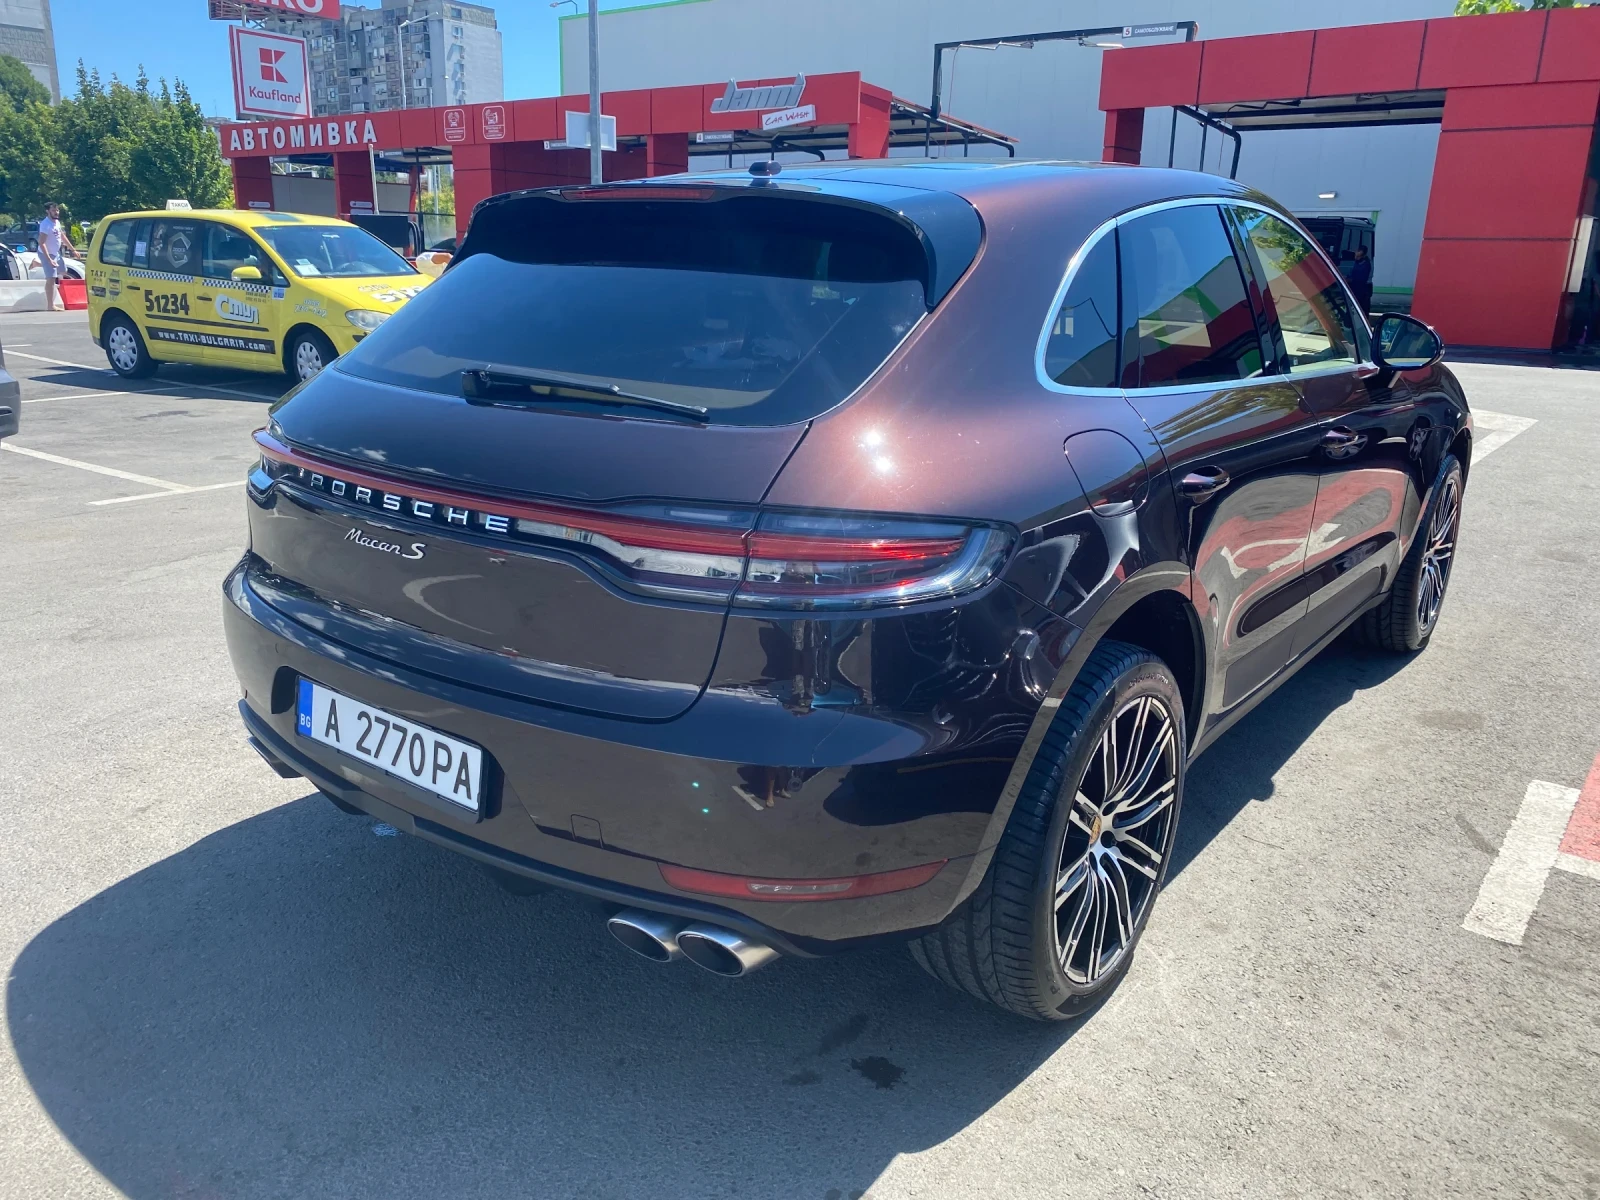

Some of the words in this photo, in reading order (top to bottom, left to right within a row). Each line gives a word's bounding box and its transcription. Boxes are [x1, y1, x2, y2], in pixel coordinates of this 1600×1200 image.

[249, 86, 301, 104] Kaufland
[230, 119, 377, 151] АВТОМИВКА
[91, 270, 106, 278] TAXI
[144, 290, 190, 315] 51234
[157, 331, 266, 351] www.TAXI-BULGARIA.com
[310, 472, 512, 534] PORSCHE
[344, 527, 402, 555] Macan
[401, 541, 426, 561] S
[300, 713, 311, 729] BG
